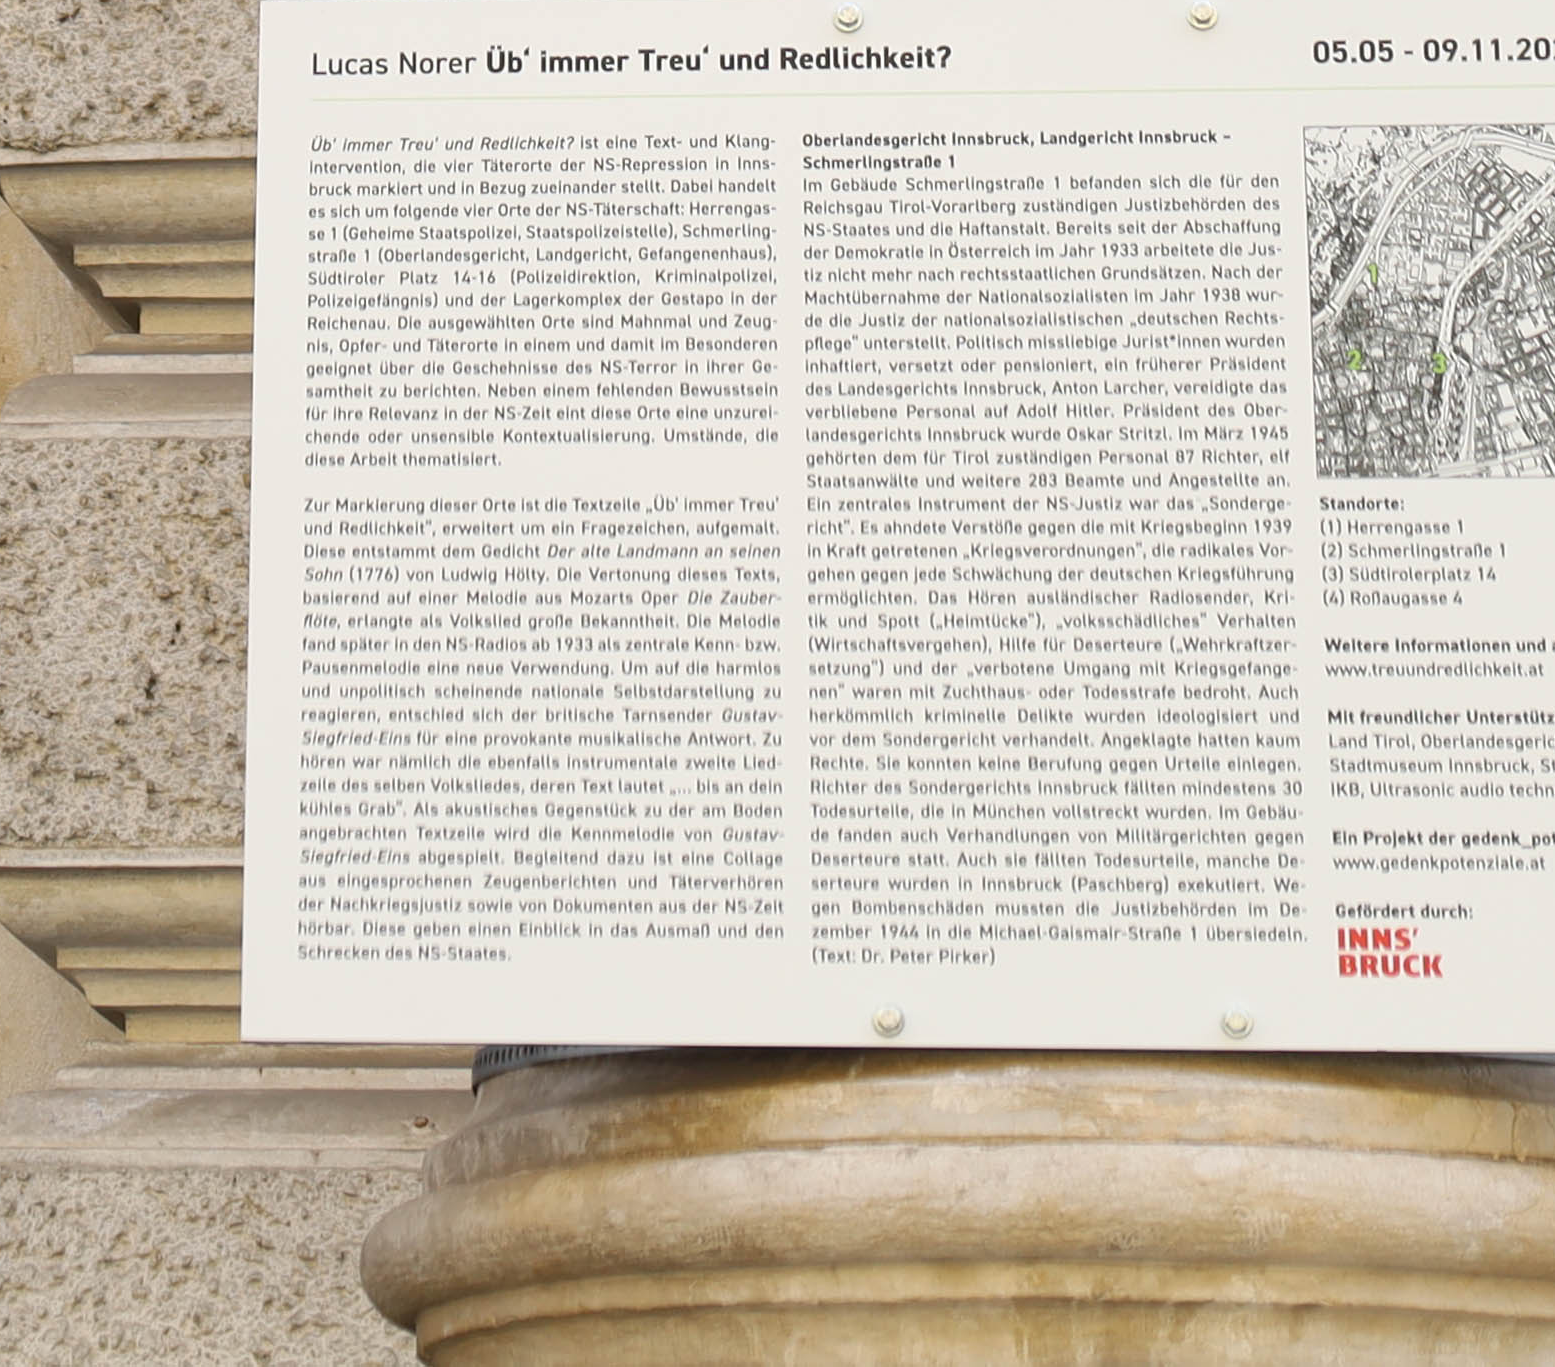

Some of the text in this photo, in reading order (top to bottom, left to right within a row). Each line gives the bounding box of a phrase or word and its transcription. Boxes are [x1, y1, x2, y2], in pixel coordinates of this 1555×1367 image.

[312, 52, 388, 76] Lucas
[399, 51, 477, 75] Norer
[540, 49, 630, 73] immer
[719, 46, 769, 71] und
[779, 44, 952, 70] Redlichkeit?
[1312, 39, 1394, 64] 05.05
[342, 137, 393, 152] immer
[444, 136, 474, 151] und
[479, 135, 575, 151] Redlichkeit?
[580, 134, 599, 150] ist
[605, 134, 637, 149] eine
[644, 134, 682, 149] Text-
[689, 134, 717, 148] und
[725, 133, 776, 151] Klang-
[802, 131, 946, 150] Oberlandesgericht
[951, 130, 1034, 148] Innsbruck,
[1040, 129, 1134, 148] Landgericht
[1138, 129, 1217, 144] Innsbruck
[413, 159, 436, 173] die
[443, 158, 473, 173] vier
[480, 158, 552, 172] Täterorte
[559, 157, 586, 172] der
[593, 156, 707, 175] NS-Repression
[715, 156, 729, 171] in
[737, 156, 775, 170] Inns-
[803, 154, 955, 172] Schmerlingstraße 1
[308, 177, 776, 198] bruck markiert und in Bezug zueinander stellt. Dabei handelt
[803, 173, 1279, 194] Im Gebäude Schmerlingstraße 1 befanden sich die für den
[803, 196, 1280, 217] Reichsgau Tirol-Vorarlberg zuständigen Justizbehörden des
[803, 218, 1281, 237] NS-Staates und die Haftanstalt. Bereits seit der Abschaffung
[1348, 349, 1363, 371] 2
[1432, 352, 1448, 374] 3
[304, 451, 501, 466] diese Arbeit thematisiert.
[1319, 495, 1404, 511] Standorte:
[1320, 517, 1463, 537] (1) Herrengasse 1
[1321, 541, 1505, 561] (2) Schmerlingstraße 1
[1322, 564, 1496, 585] (3) Südtirolerplatz 14
[1322, 588, 1462, 609] (4) Roßaugasse 4
[1324, 637, 1389, 653] Weitere
[1394, 637, 1511, 653] Informationen
[1515, 637, 1546, 653] und
[1327, 708, 1355, 725] Mit
[1359, 708, 1461, 725] freundlicher
[1328, 733, 1367, 749] Land
[1373, 733, 1415, 751] Tirol,
[1329, 757, 1443, 773] Stadtmuseum
[1448, 757, 1535, 776] Innsbruck,
[1330, 781, 1364, 799] IKB,
[1370, 781, 1454, 797] Ultrasonic
[1460, 781, 1504, 797] audio
[1332, 829, 1358, 846] Ein
[1362, 829, 1423, 849] Projekt
[1428, 829, 1456, 846] der
[1335, 902, 1473, 920] Gefördert durch:
[297, 919, 784, 939] hörbar. Diese geben einen Einblick in das Ausmaß und den
[297, 944, 510, 961] Schrecken des NS-Staates.
[812, 946, 995, 966] (Text: Dr. Peter Pirker)
[1338, 953, 1444, 979] BRUCK
